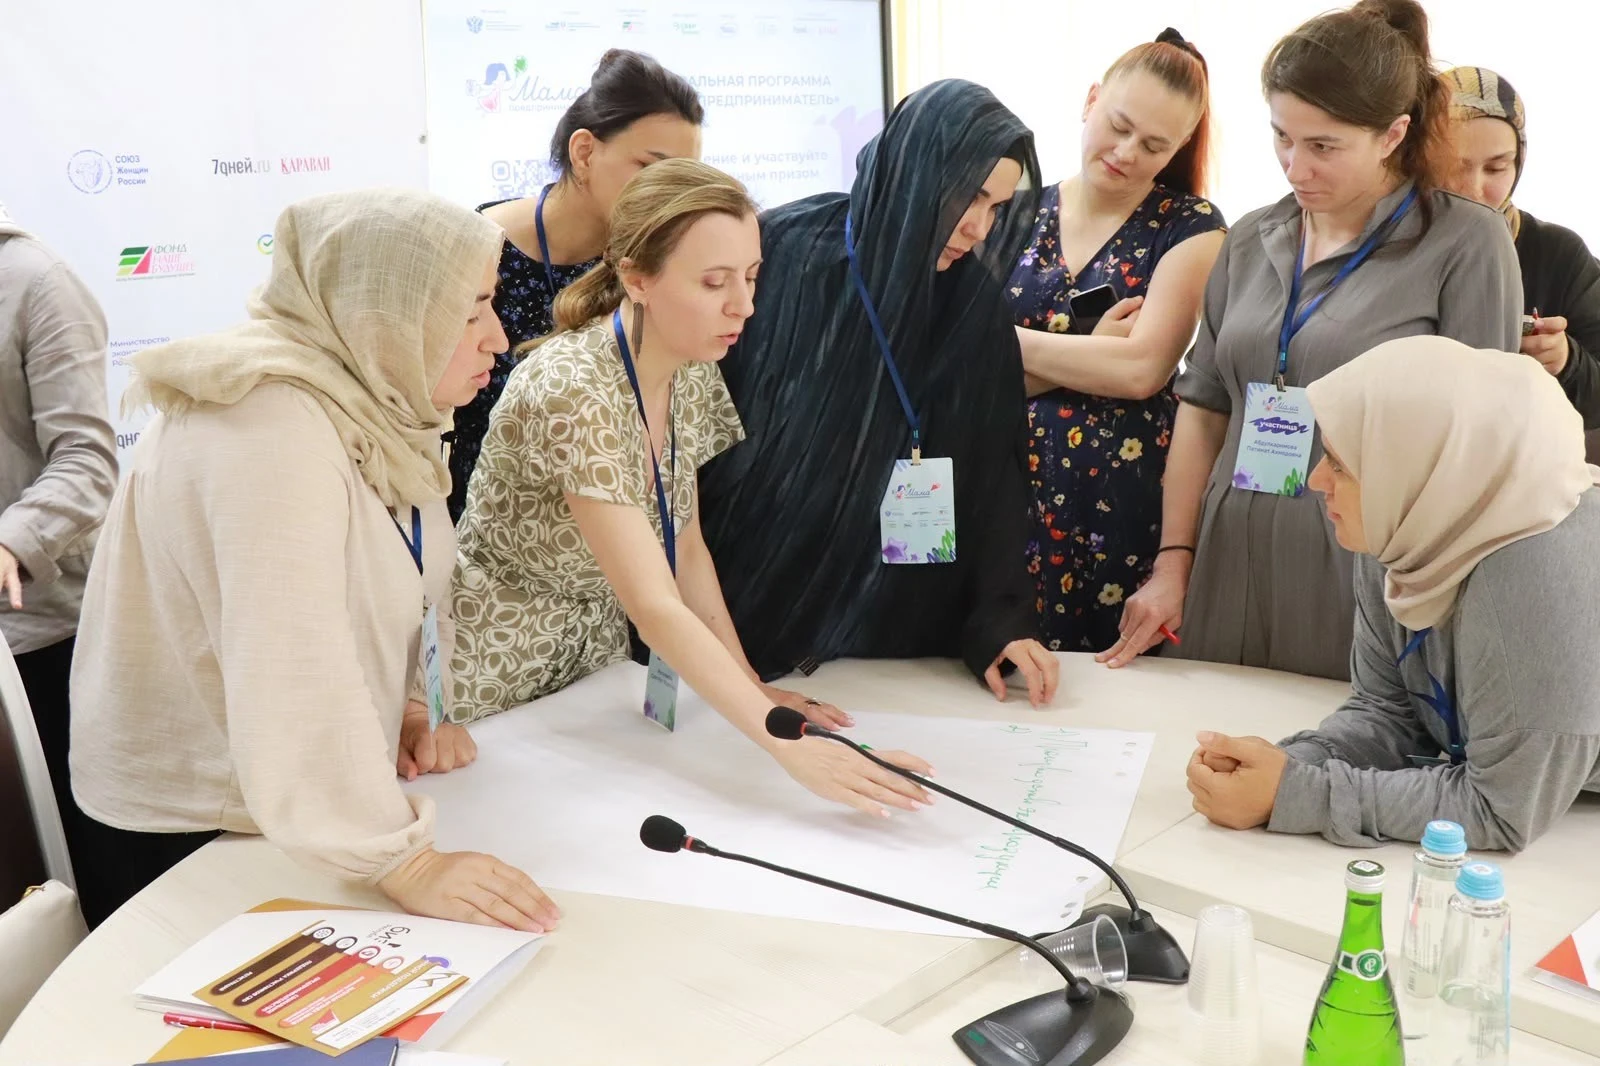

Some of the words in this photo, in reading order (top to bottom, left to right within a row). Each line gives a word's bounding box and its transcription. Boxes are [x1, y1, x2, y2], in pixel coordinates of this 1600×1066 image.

[688, 75, 744, 87] АЛЬНАЯ
[749, 75, 832, 87] ПРОГРАММА
[115, 155, 140, 164] СОЮЗ
[703, 154, 738, 165] ение
[742, 153, 751, 164] и
[754, 151, 828, 165] участвуйте
[280, 156, 330, 174] КАРАВАН
[117, 167, 149, 175] Женщин
[736, 171, 767, 181] ным
[769, 169, 820, 183] призом
[118, 177, 146, 185] России
[154, 244, 187, 254] ФОНД
[110, 337, 170, 348] Министерство
[1260, 421, 1298, 431] участница
